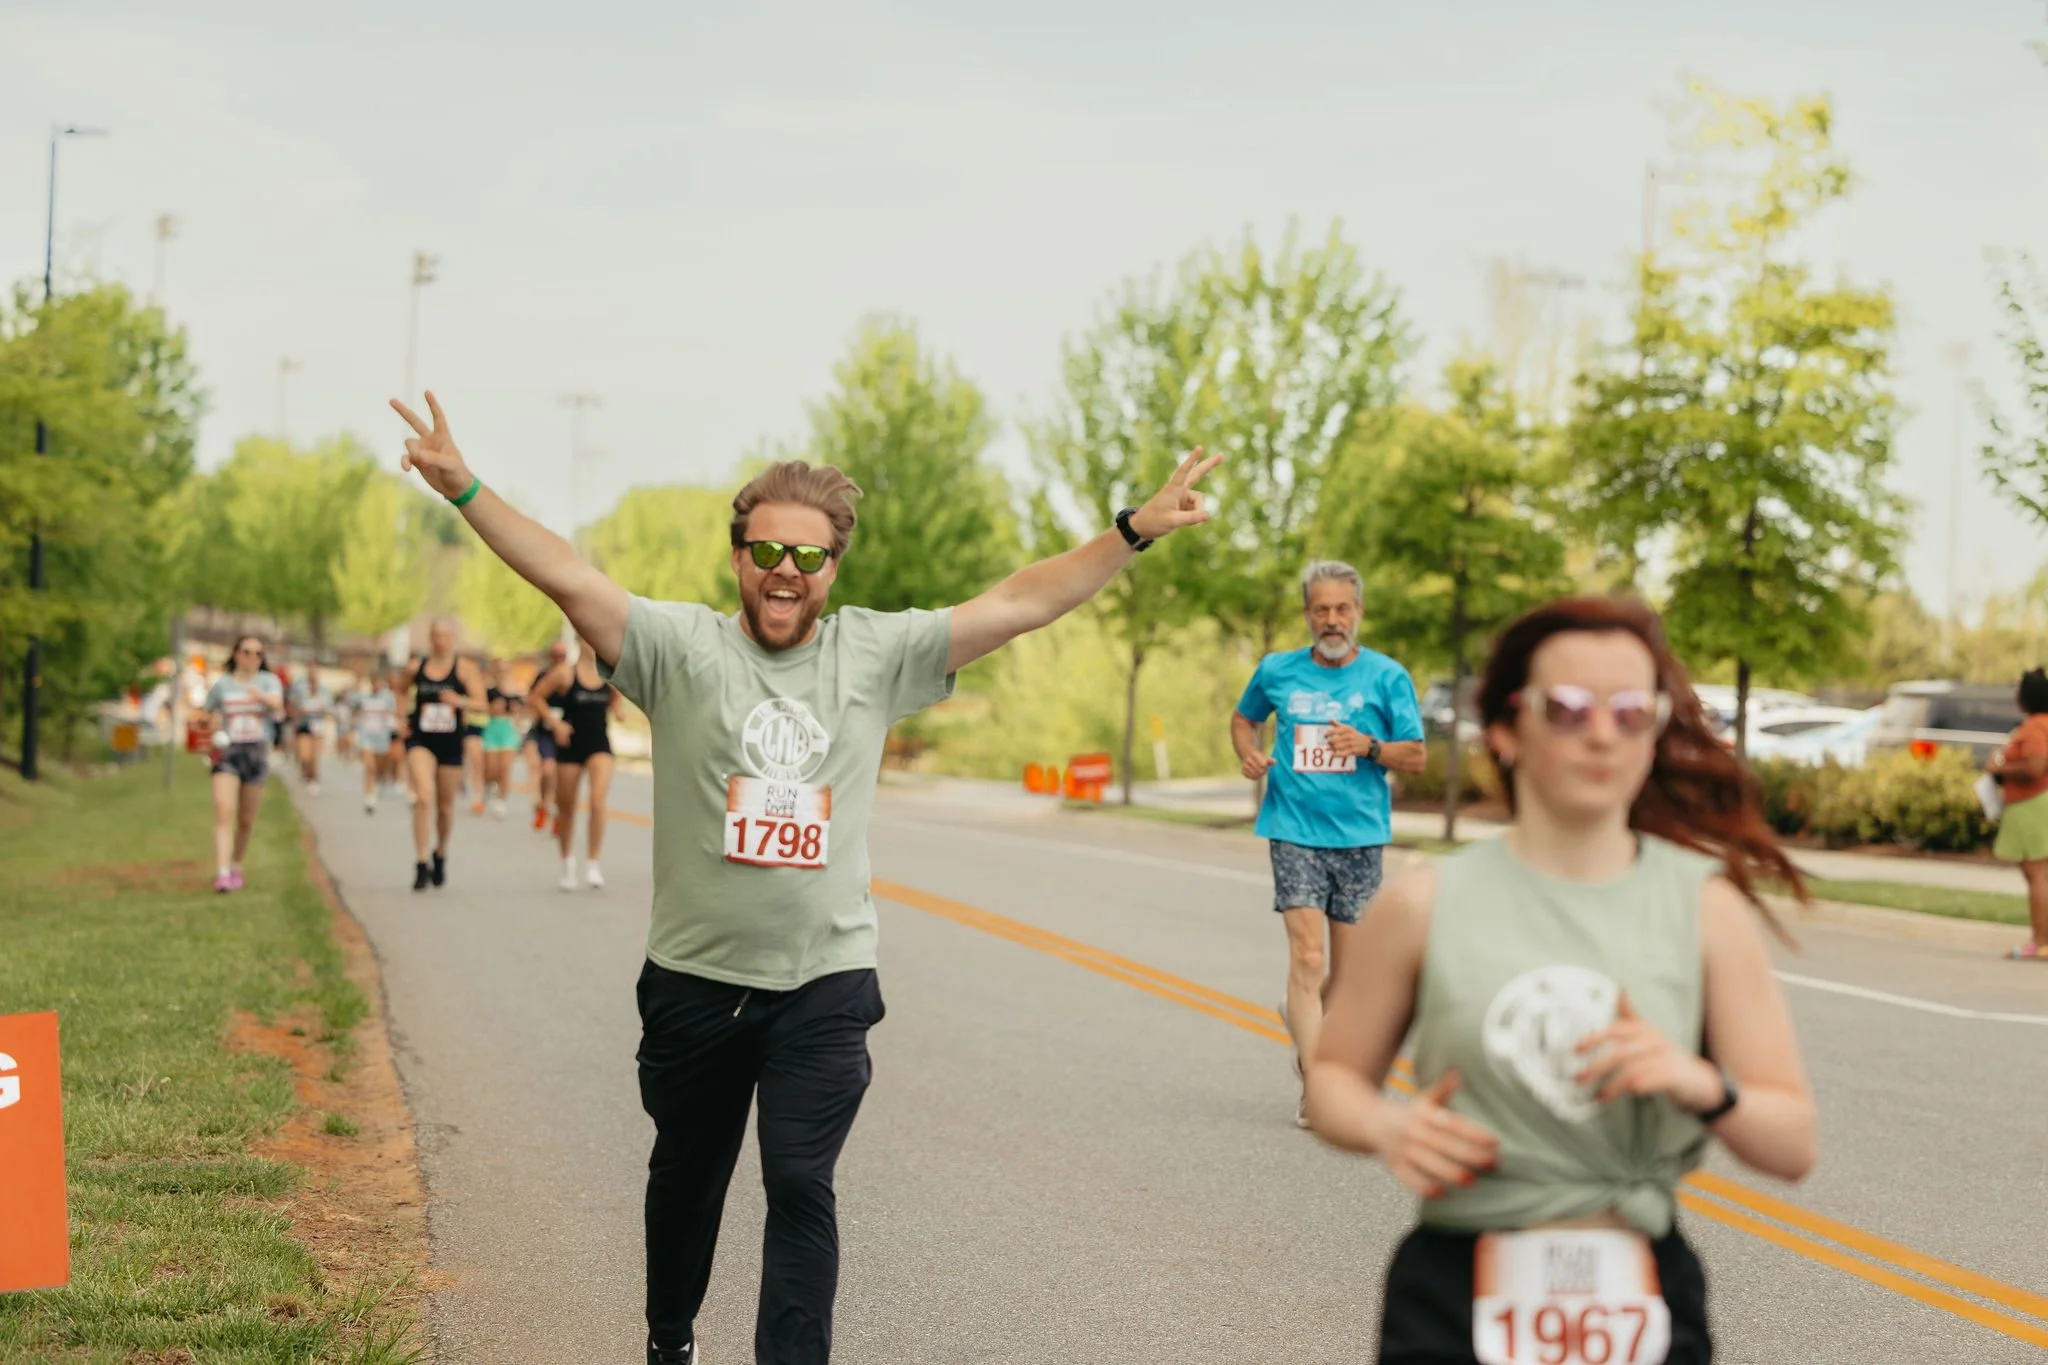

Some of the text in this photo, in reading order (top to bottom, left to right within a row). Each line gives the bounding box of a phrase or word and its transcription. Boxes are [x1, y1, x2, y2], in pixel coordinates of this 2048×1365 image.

[767, 785, 798, 799] RUN
[732, 817, 822, 860] 1798
[1493, 1305, 1649, 1365] 1967
